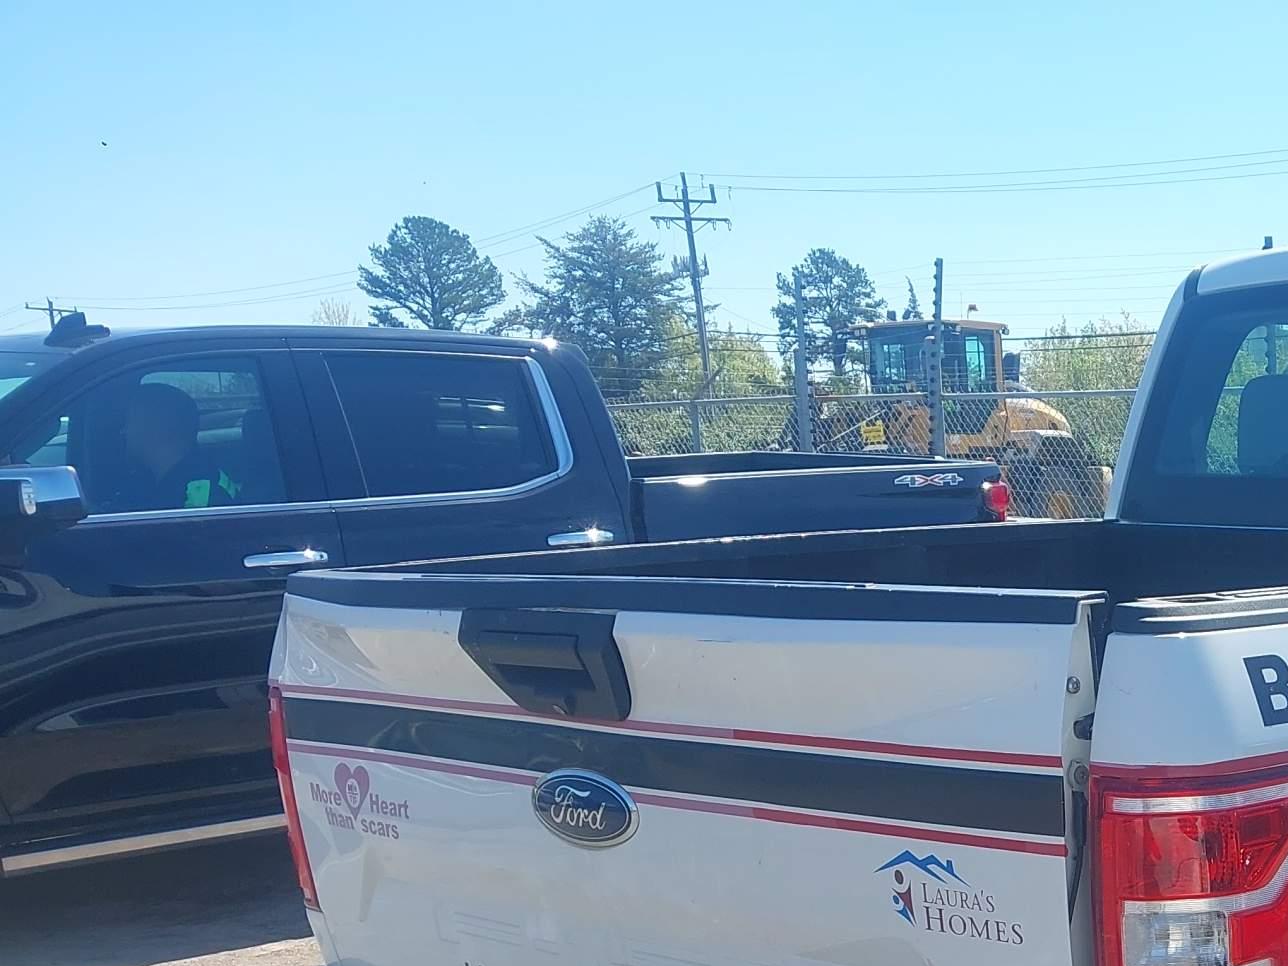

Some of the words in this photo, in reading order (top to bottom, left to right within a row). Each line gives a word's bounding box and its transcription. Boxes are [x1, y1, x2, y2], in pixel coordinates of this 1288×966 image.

[310, 782, 342, 807] More
[369, 795, 409, 819] Heart
[551, 785, 606, 830] Ford
[325, 809, 354, 829] than
[361, 817, 399, 840] scars
[921, 883, 995, 913] LAURA'S
[923, 905, 1024, 945] HOMES
